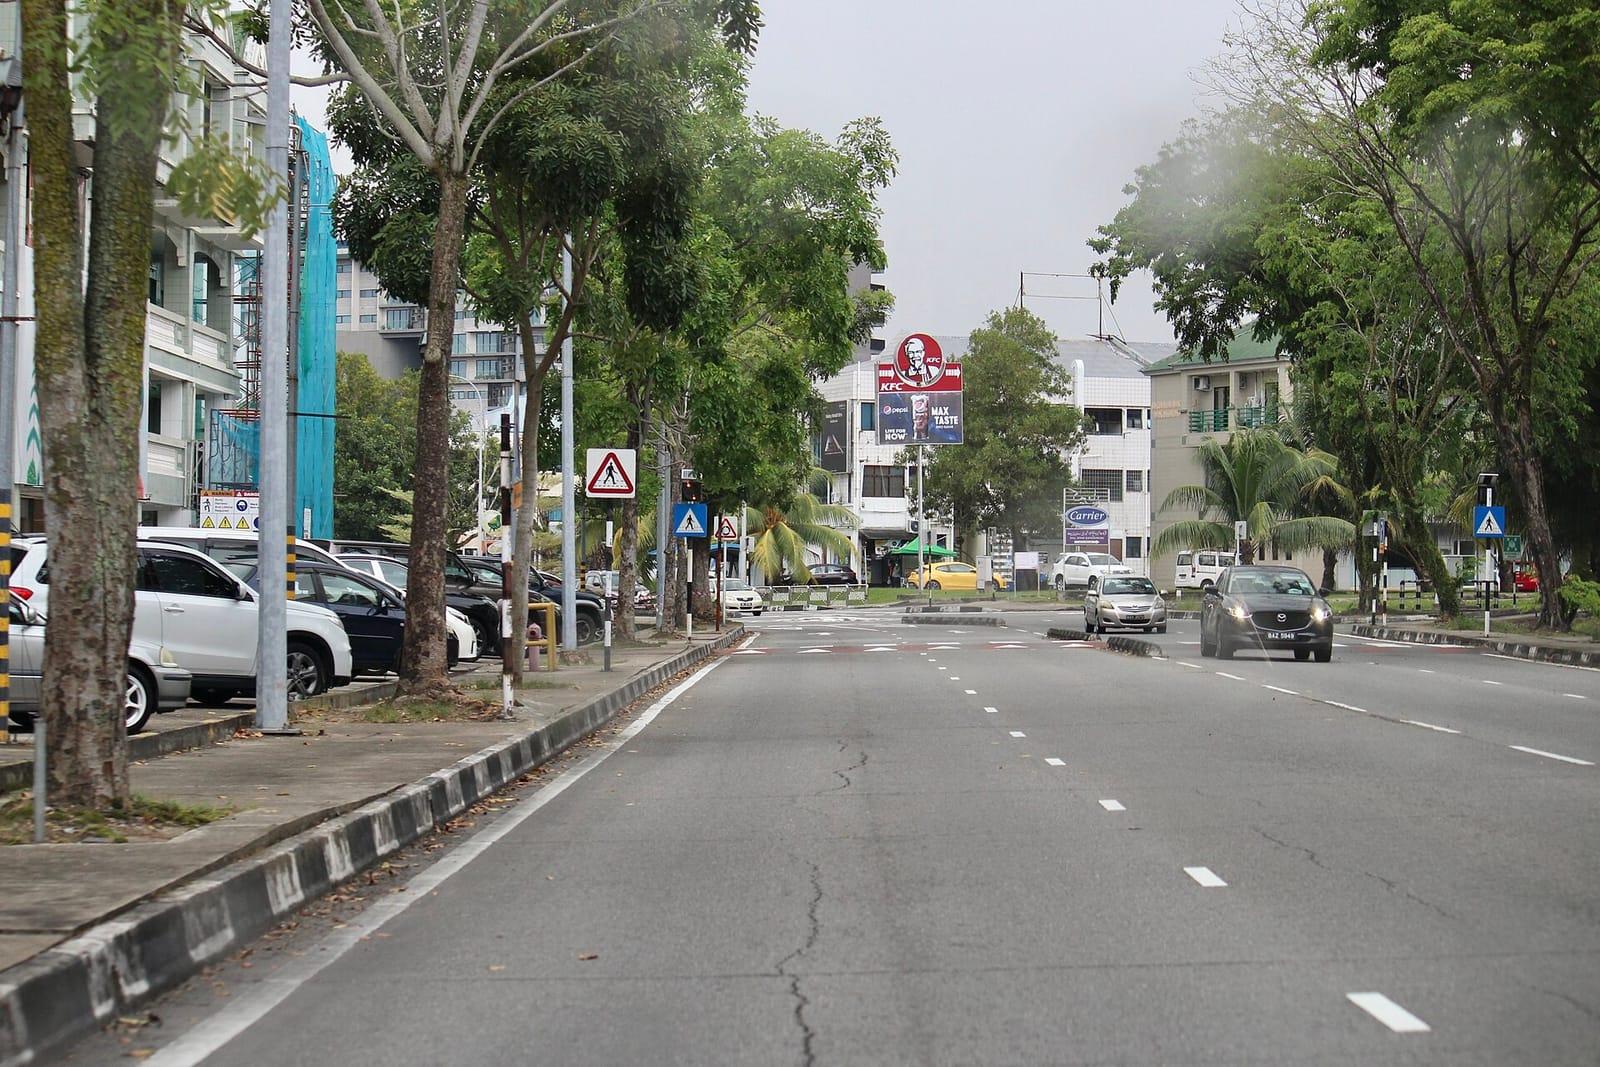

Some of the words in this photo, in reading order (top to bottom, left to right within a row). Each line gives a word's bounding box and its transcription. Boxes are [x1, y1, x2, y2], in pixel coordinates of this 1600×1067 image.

[880, 382, 904, 390] KFC
[931, 406, 949, 416] MAX
[934, 416, 958, 425] TASTE
[1070, 511, 1104, 520] Carrier
